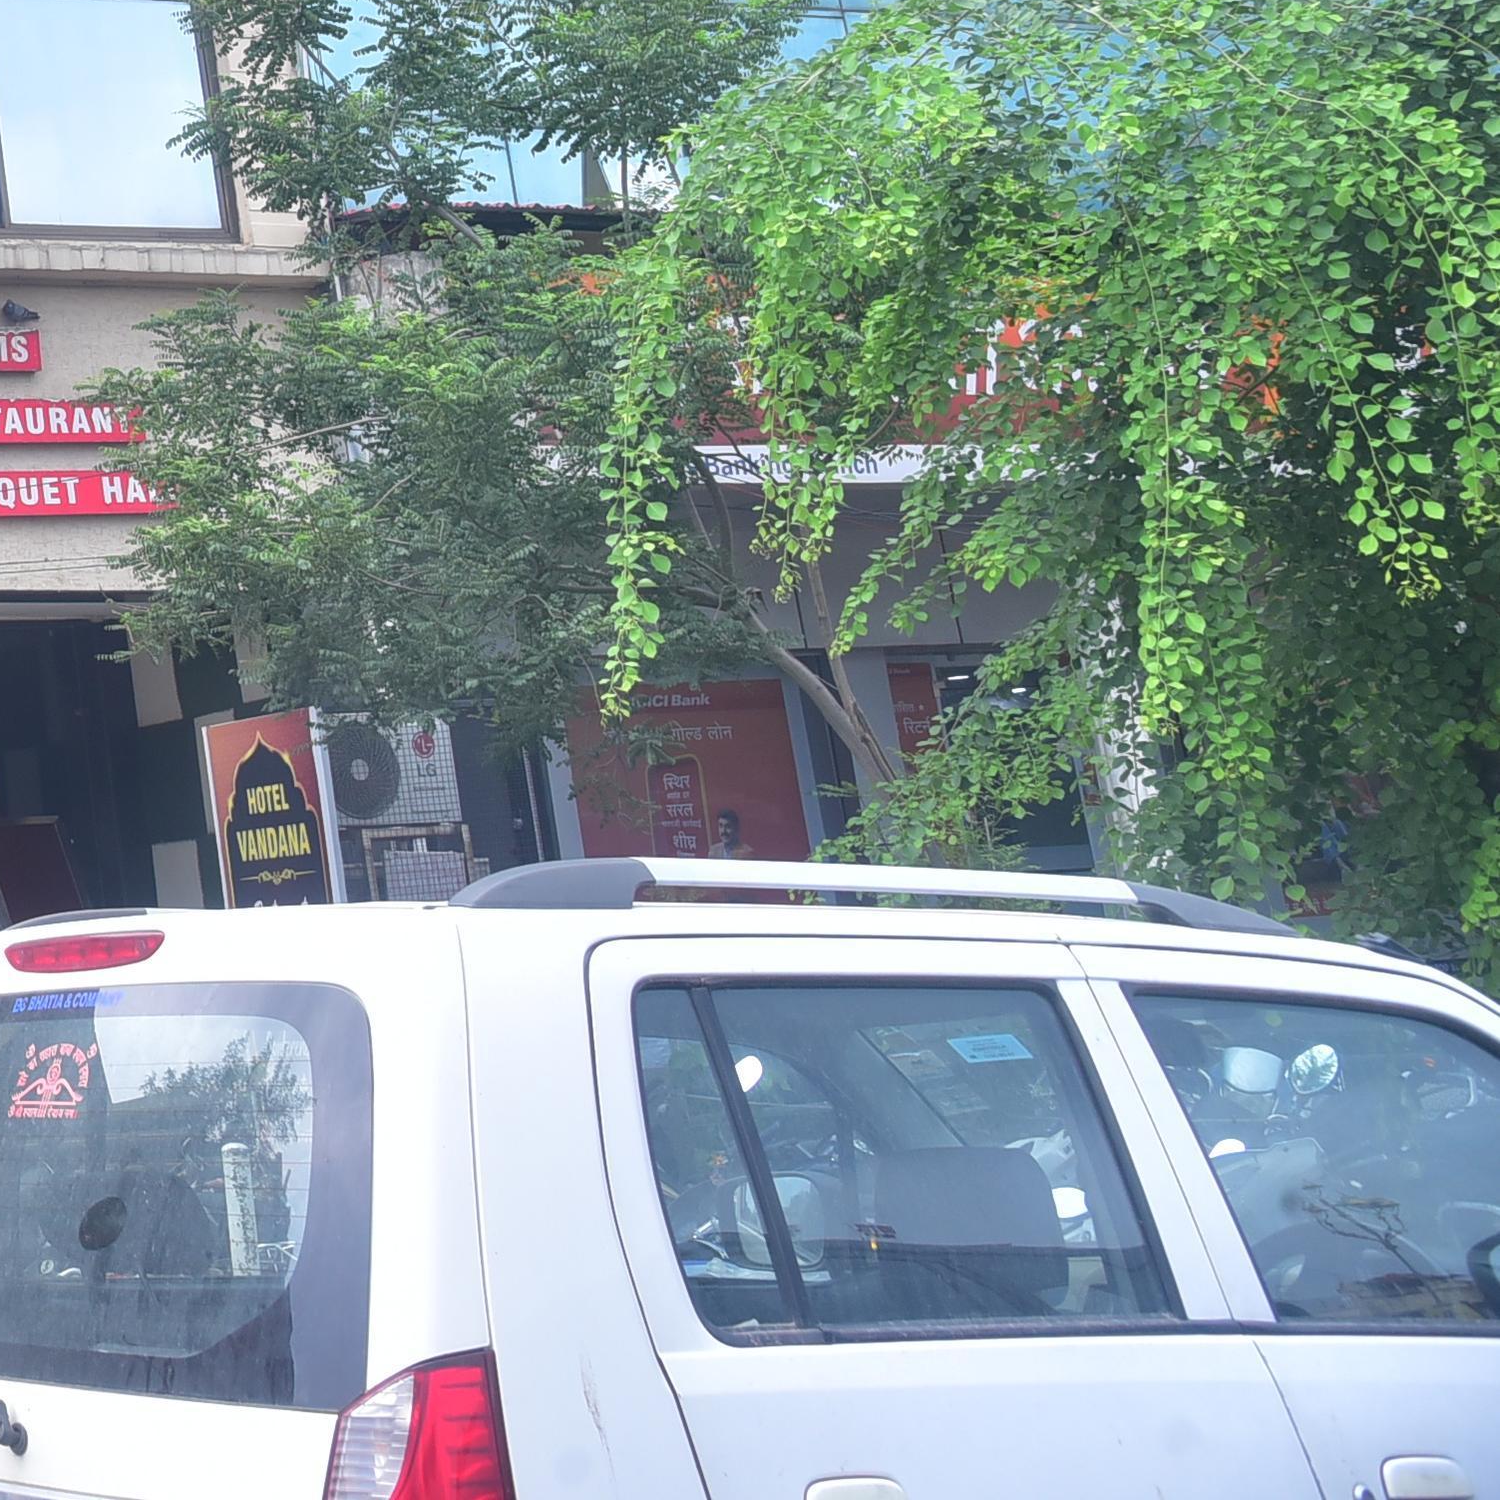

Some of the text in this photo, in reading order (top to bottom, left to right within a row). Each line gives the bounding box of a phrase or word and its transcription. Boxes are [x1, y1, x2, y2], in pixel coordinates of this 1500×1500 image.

[671, 693, 710, 707] Bank
[417, 763, 437, 777] LG
[247, 783, 289, 815] HOTEL
[236, 822, 311, 862] VANDANA
